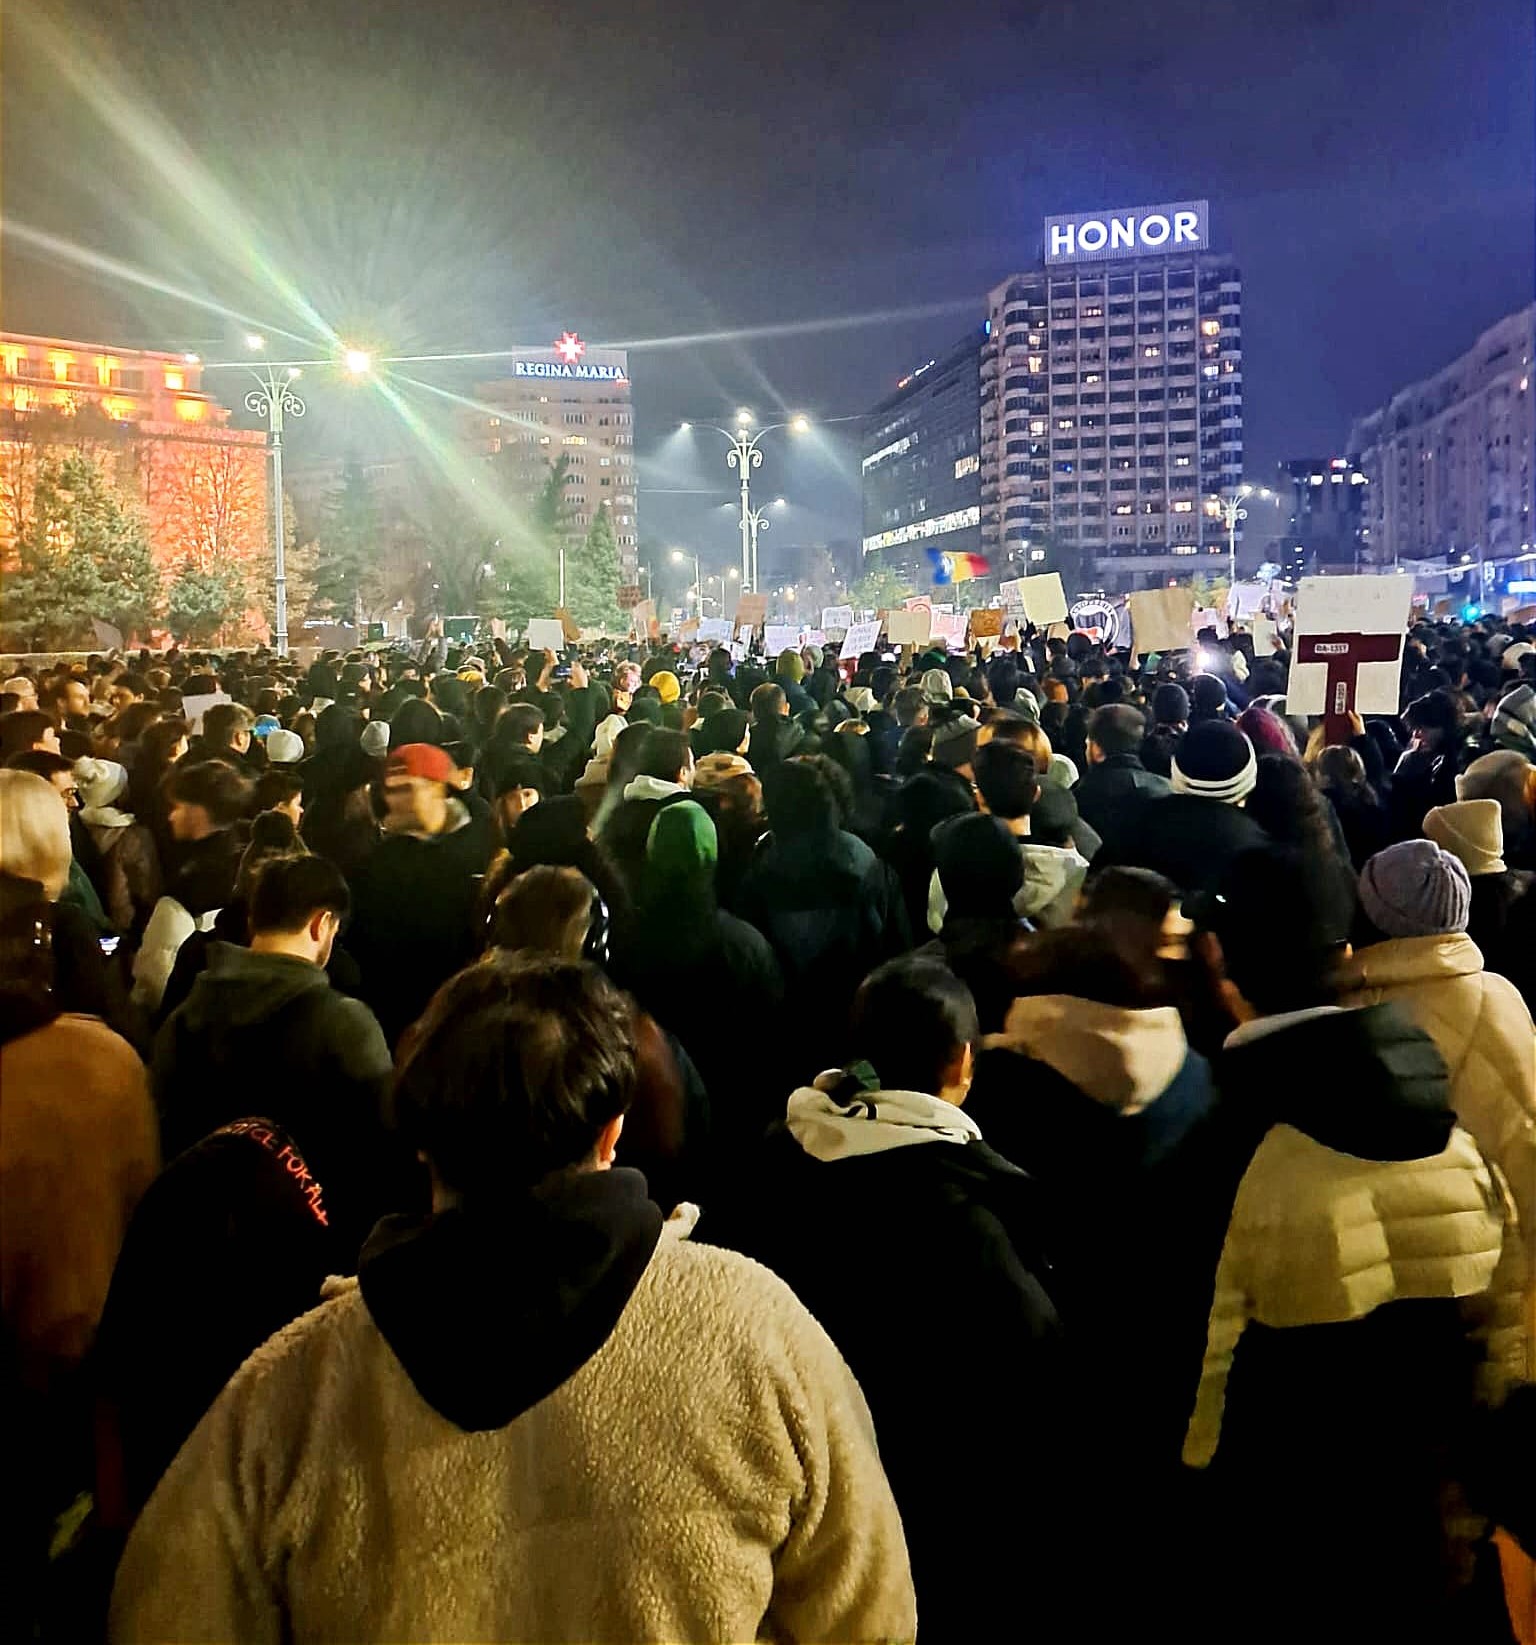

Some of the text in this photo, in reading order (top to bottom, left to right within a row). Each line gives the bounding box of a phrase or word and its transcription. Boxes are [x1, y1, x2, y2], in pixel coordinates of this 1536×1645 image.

[1051, 211, 1200, 256] HONOR
[515, 362, 625, 380] REGINA MARIA
